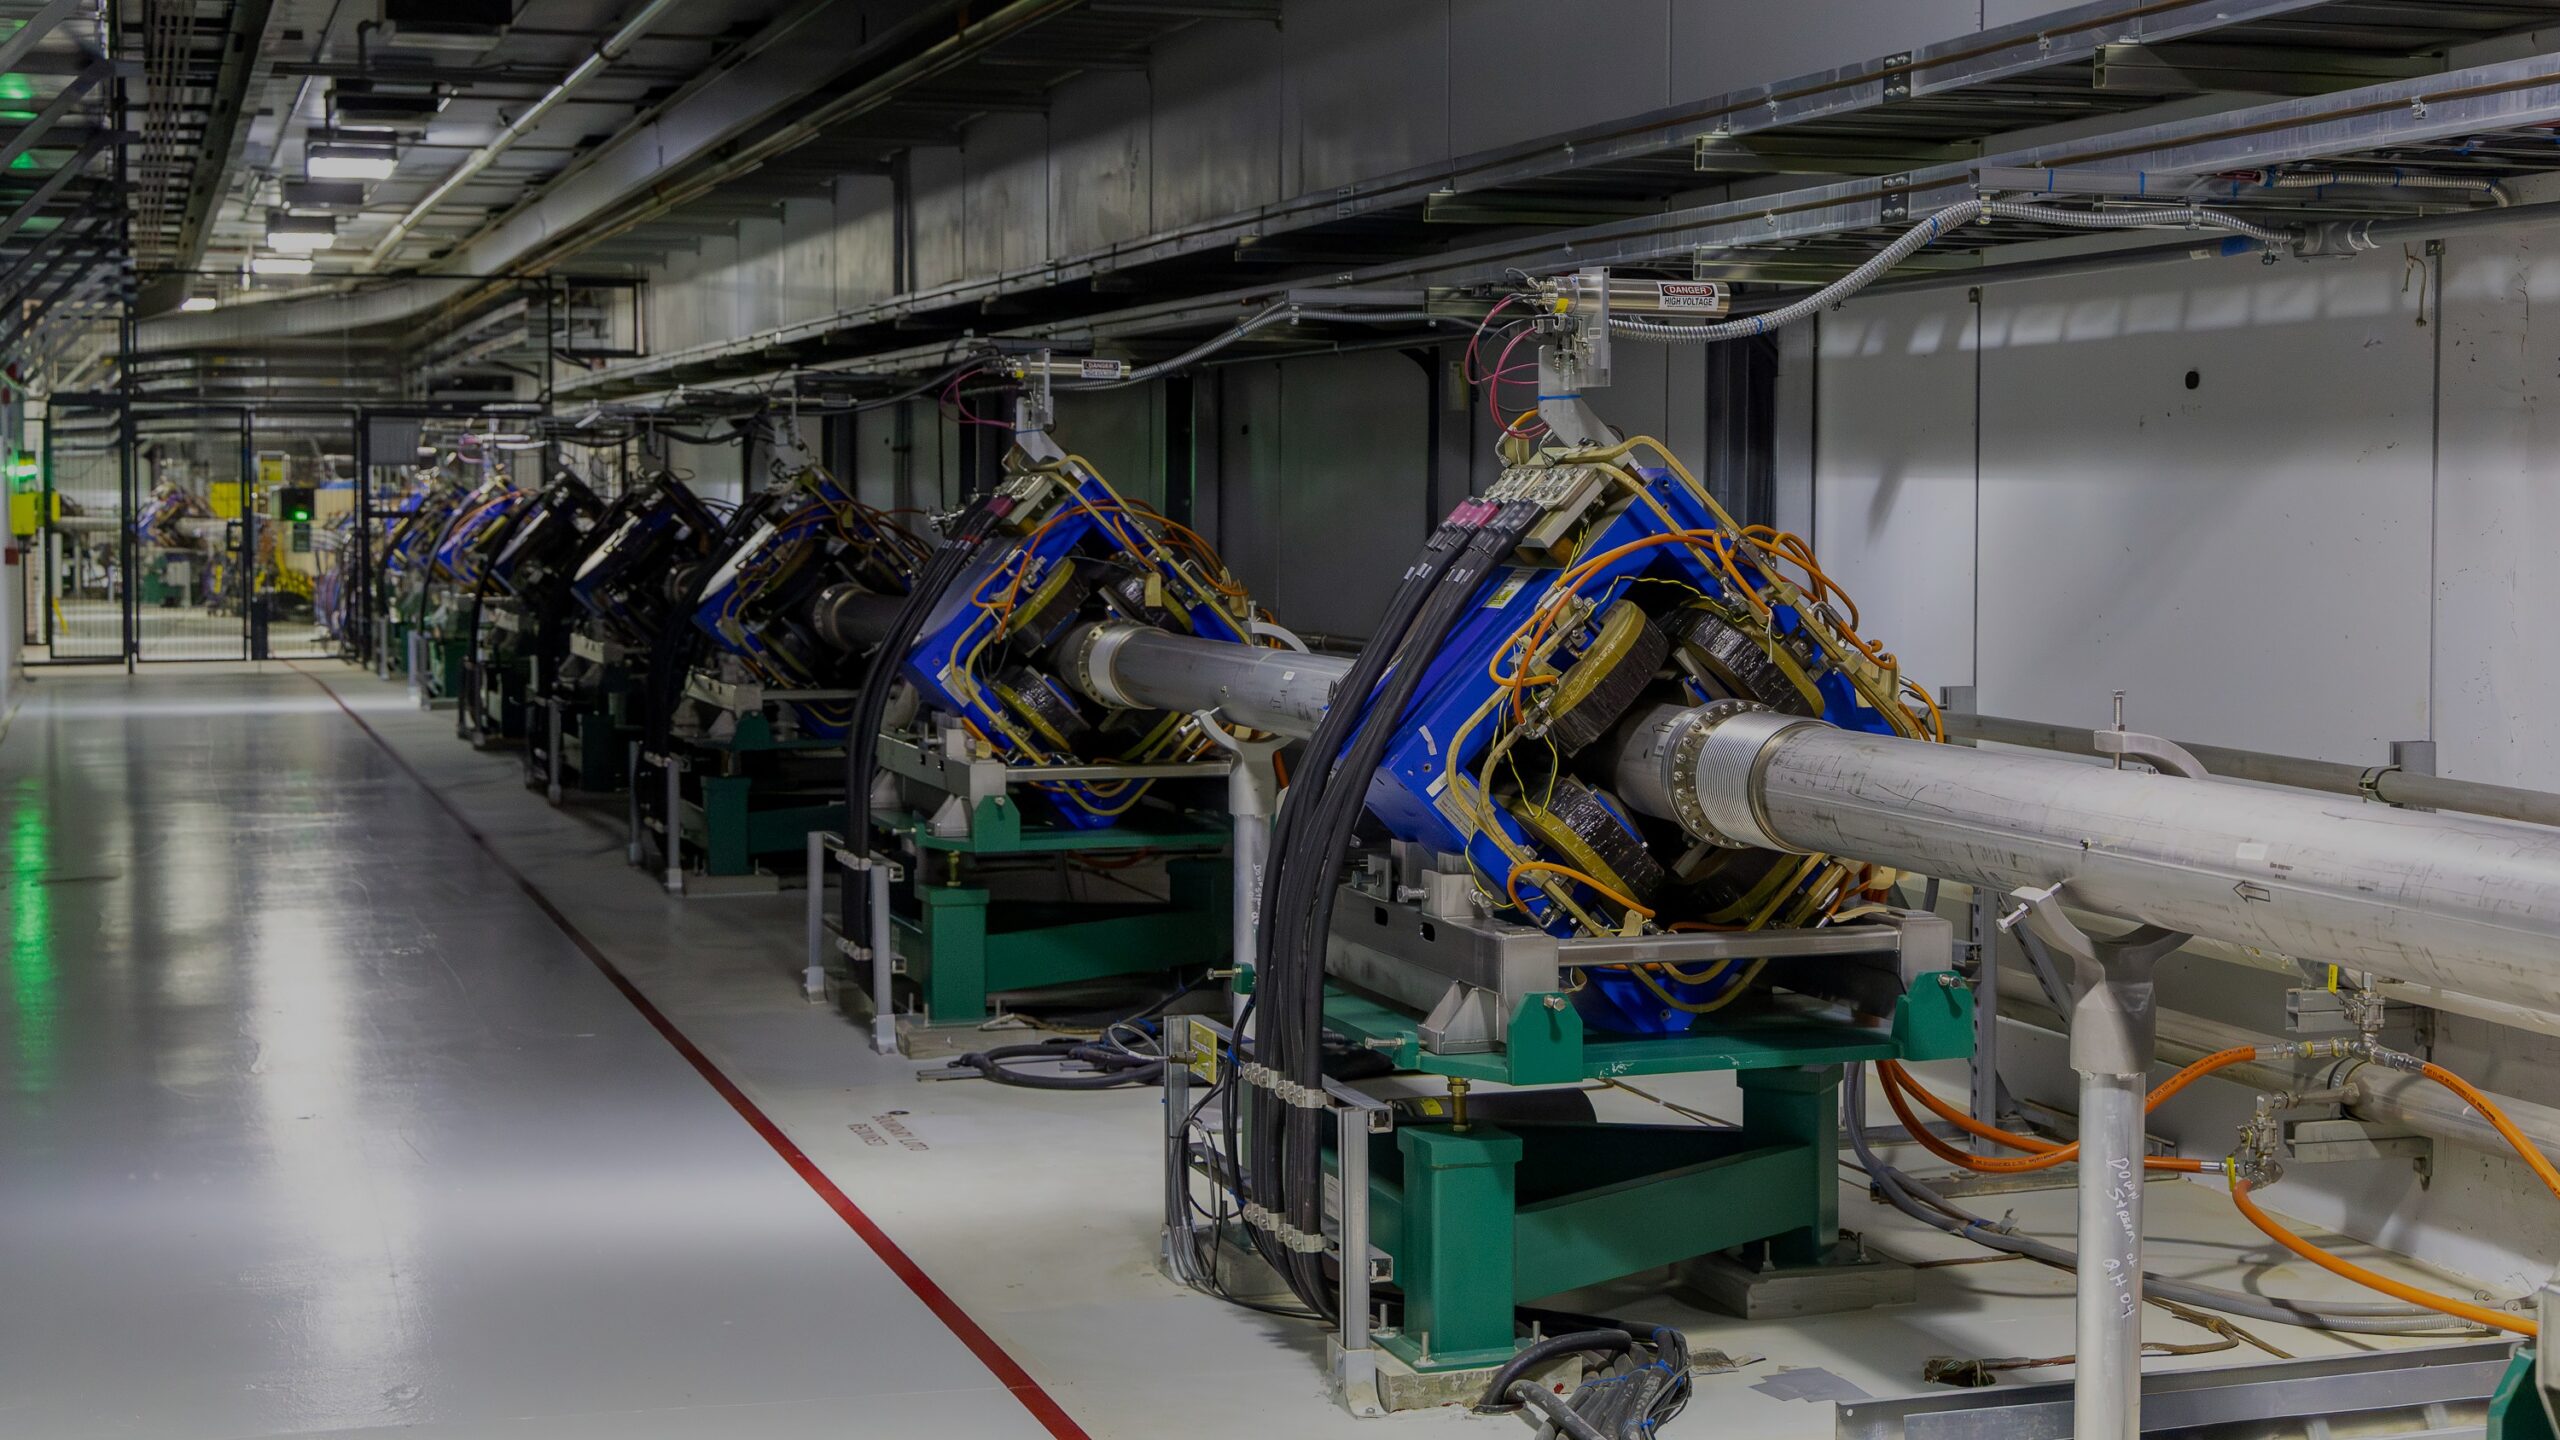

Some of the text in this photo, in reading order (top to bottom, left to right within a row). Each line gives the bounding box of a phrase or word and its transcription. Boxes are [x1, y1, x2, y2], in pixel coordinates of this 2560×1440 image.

[1669, 286, 1707, 294] DANGER
[1664, 297, 1713, 306] HIGH VOLTAGE
